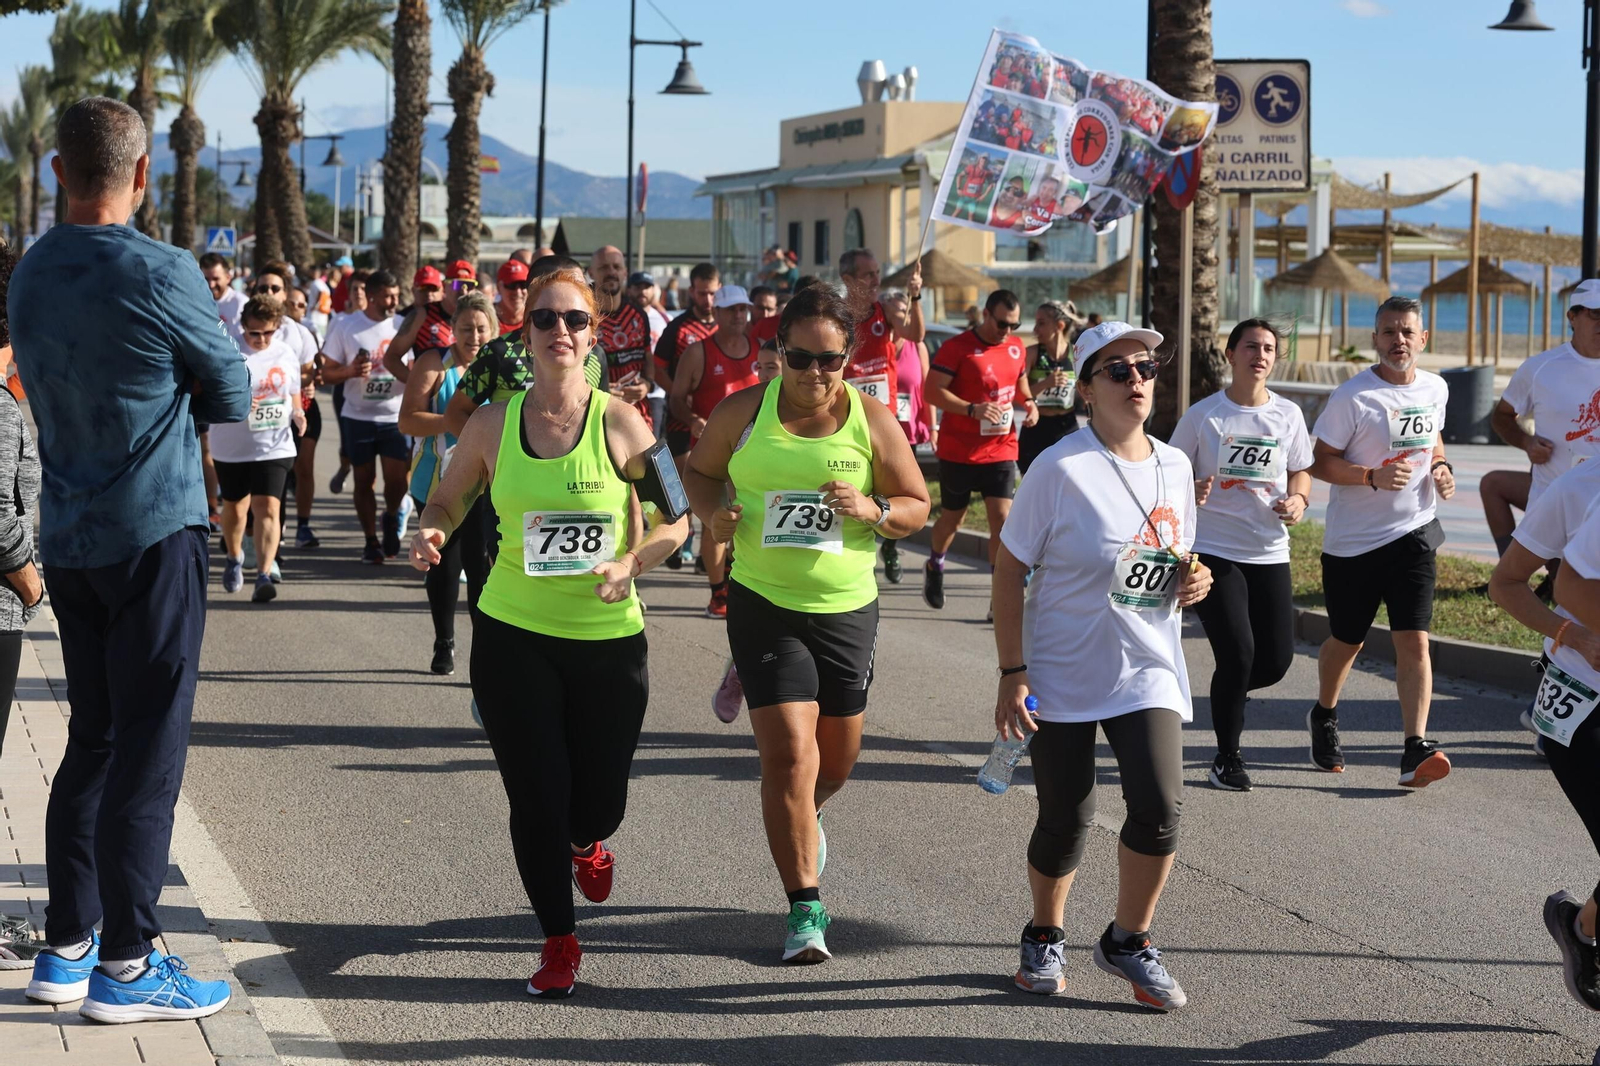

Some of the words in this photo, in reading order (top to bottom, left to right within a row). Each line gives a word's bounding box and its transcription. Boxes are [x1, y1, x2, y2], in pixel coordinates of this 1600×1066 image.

[1083, 106, 1115, 139] CORREDORES
[1259, 134, 1296, 143] PATINES
[1105, 142, 1114, 158] CON
[1231, 152, 1293, 164] CARRIL
[1091, 159, 1107, 174] MIGA
[1216, 167, 1302, 181] ÑALIZADO
[366, 382, 392, 394] 842
[255, 407, 283, 421] 559
[991, 412, 1009, 426] 9
[1399, 414, 1433, 436] 765
[1227, 445, 1272, 467] 764
[827, 460, 839, 468] LA
[840, 461, 861, 469] TRIBU
[567, 482, 578, 490] LA
[579, 481, 604, 490] TRIBU
[775, 504, 834, 532] 739
[539, 525, 603, 554] 738
[1125, 562, 1177, 592] 807
[1112, 594, 1126, 603] 024
[1537, 677, 1583, 719] 535
